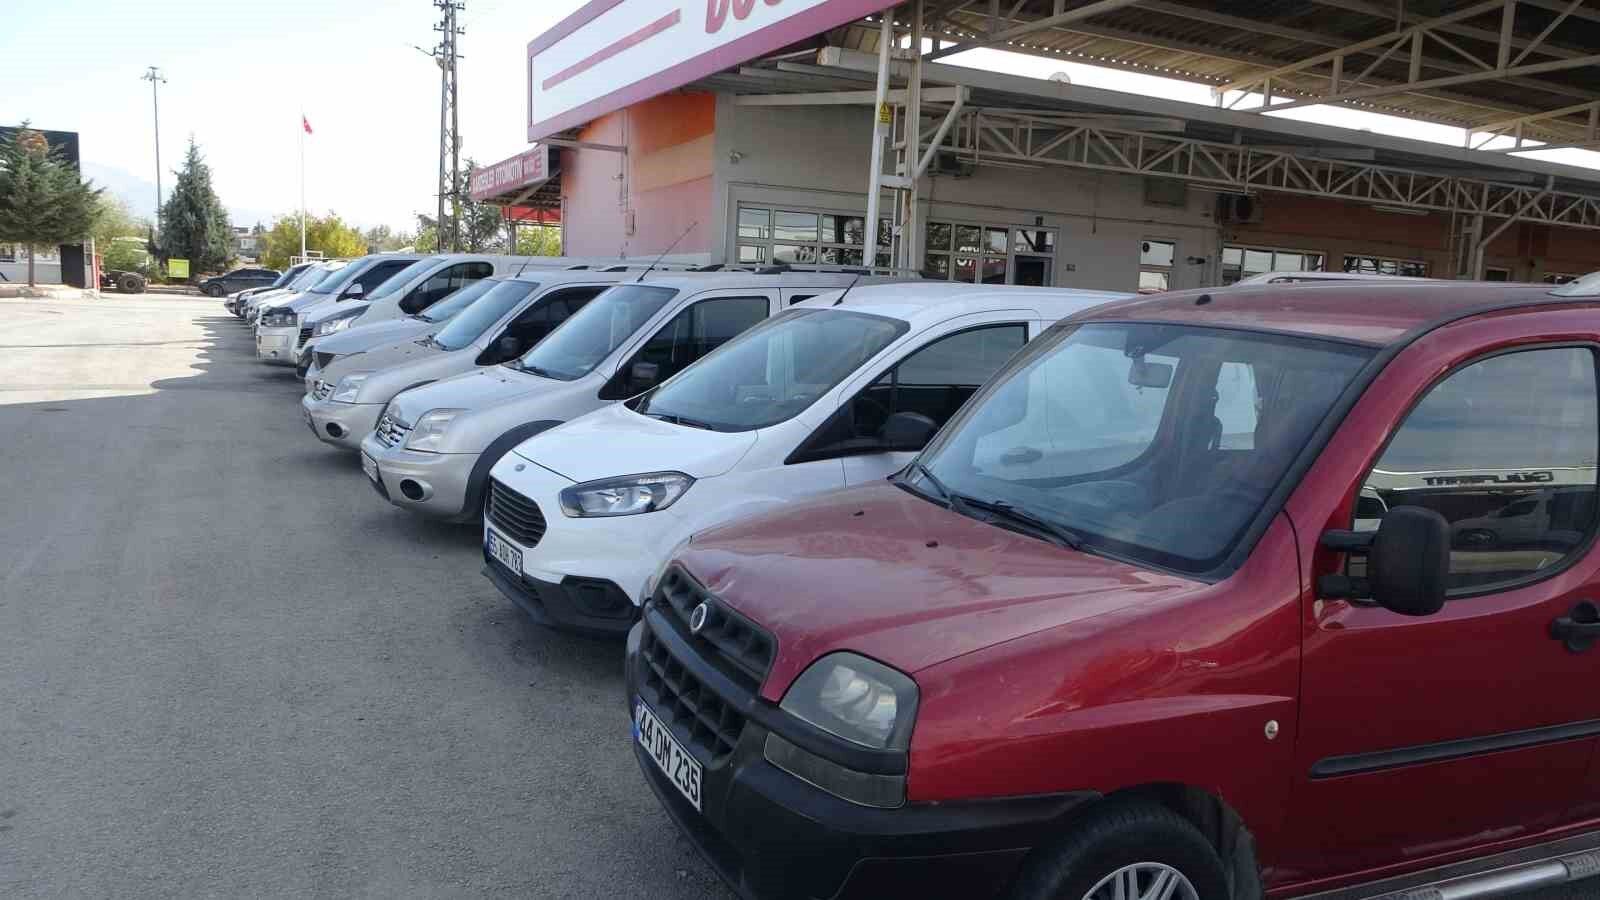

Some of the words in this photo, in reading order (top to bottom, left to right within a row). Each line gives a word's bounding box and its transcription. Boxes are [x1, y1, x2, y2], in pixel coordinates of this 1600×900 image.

[639, 710, 655, 749] 44
[655, 727, 672, 773] DM
[673, 749, 699, 803] 235
